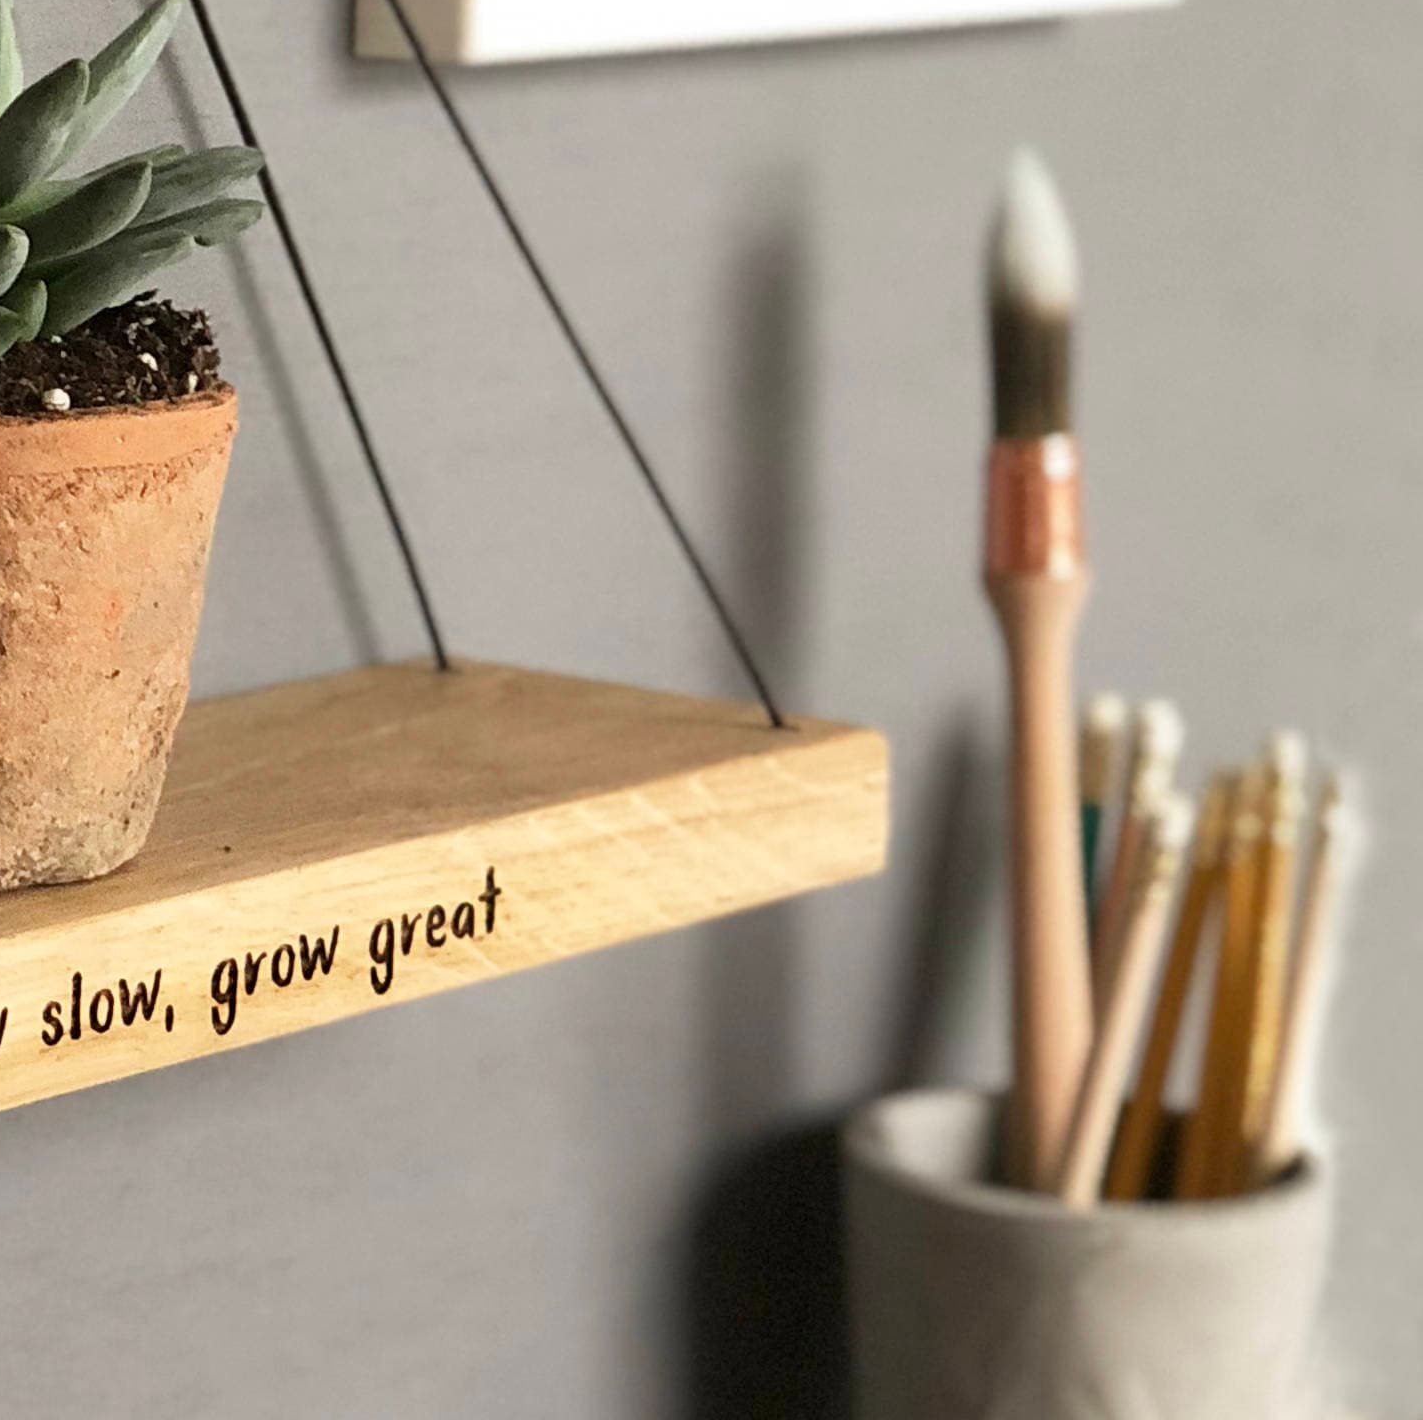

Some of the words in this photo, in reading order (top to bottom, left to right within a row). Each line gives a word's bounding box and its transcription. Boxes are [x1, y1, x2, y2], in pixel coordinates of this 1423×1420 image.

[40, 969, 174, 1048] slow,
[210, 924, 340, 1036] grow
[368, 866, 503, 995] great
